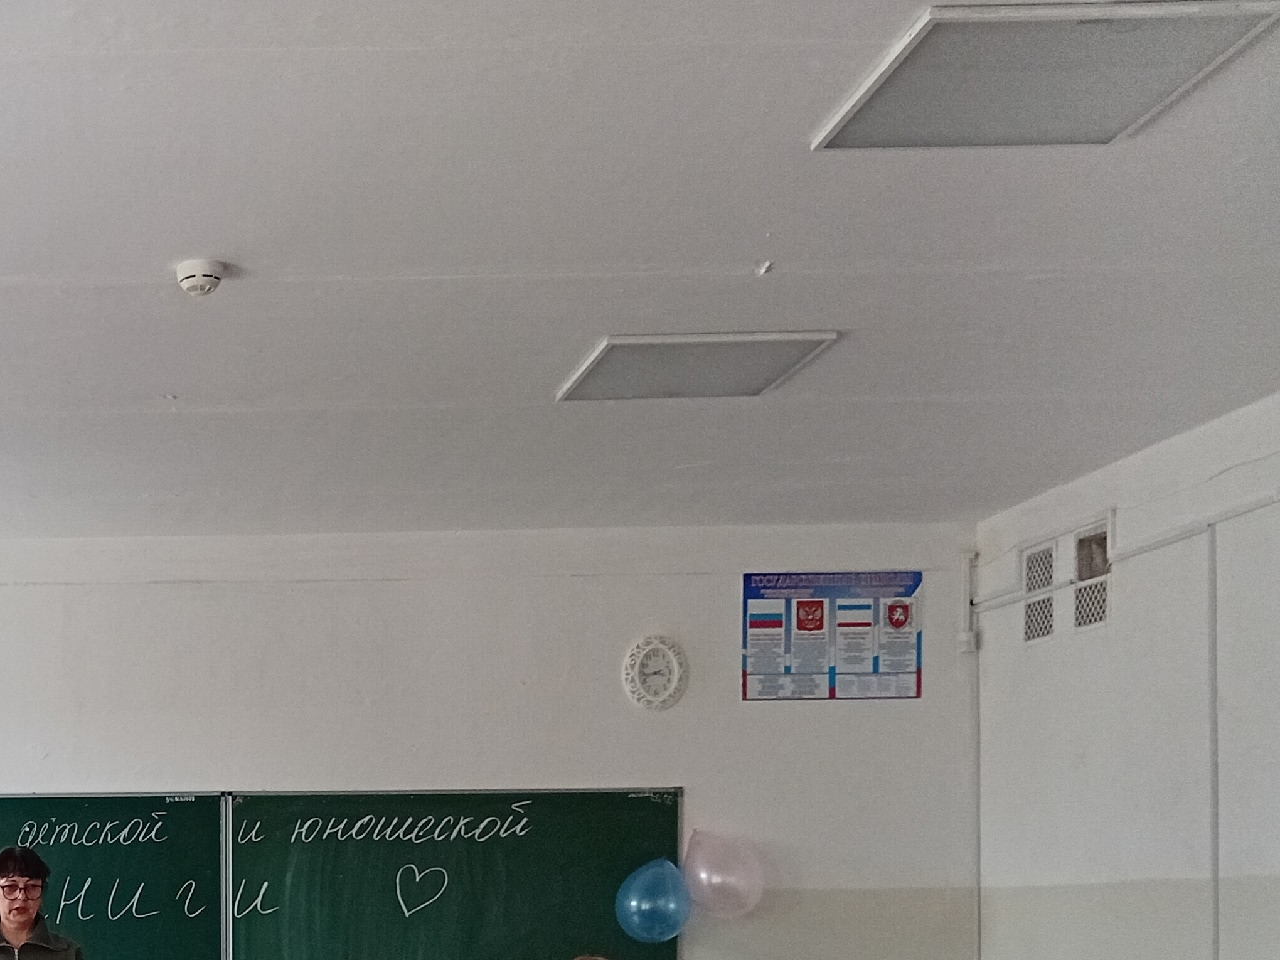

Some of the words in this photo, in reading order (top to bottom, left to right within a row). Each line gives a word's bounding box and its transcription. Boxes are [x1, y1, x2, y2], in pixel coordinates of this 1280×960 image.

[17, 811, 169, 850] детской
[237, 818, 265, 844] и
[290, 800, 533, 844] юношеской
[45, 875, 280, 925] ниги
